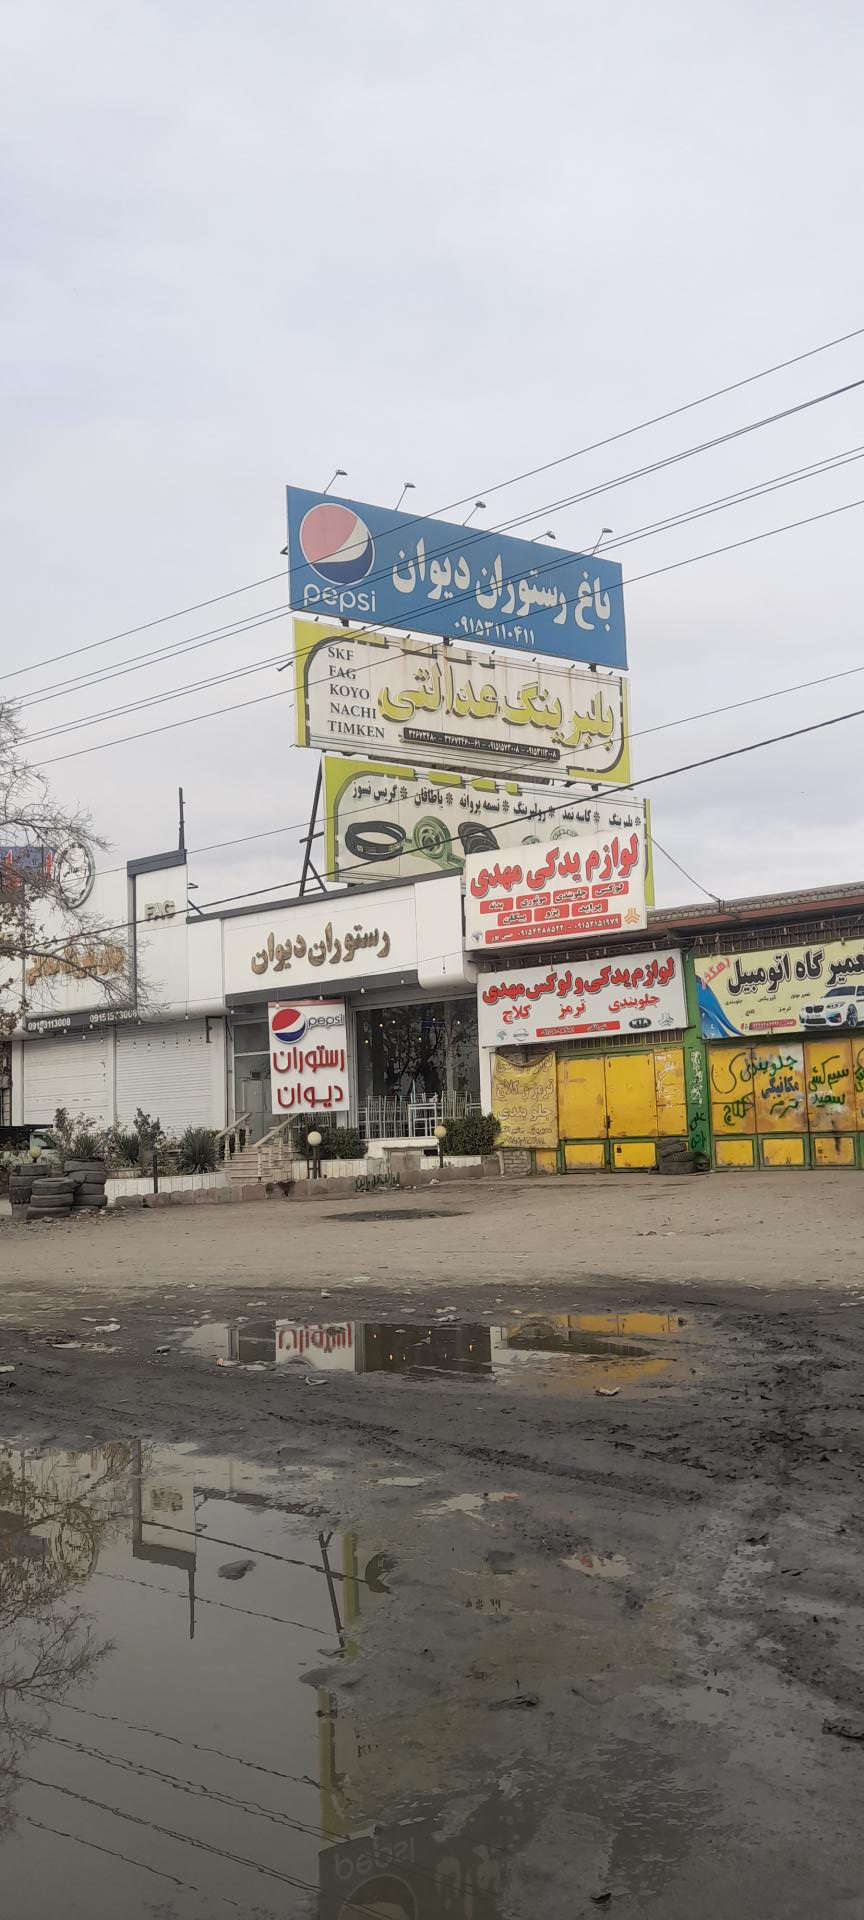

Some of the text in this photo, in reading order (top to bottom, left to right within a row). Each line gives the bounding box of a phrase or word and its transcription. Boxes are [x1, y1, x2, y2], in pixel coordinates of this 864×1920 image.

[303, 583, 376, 613] pepsi
[392, 537, 612, 632] باغ رستوران دیوان
[328, 646, 354, 661] SKF
[329, 665, 357, 680] FAG
[329, 683, 370, 700] KOYO
[330, 702, 377, 719] NACHI
[500, 680, 616, 752] بلبرینگ
[327, 720, 385, 738] TIMKEN
[470, 832, 640, 898] لوازم یدکی مهدی
[250, 921, 391, 975] رستوران دیوان
[482, 957, 675, 1005] لوازم یدکی و لوکس مهدی
[728, 948, 864, 995] عمیر گاه اتومبیل
[558, 999, 587, 1020] ترمز
[608, 992, 661, 1014] جلوبندی
[307, 1012, 345, 1030] pepsi
[272, 1045, 345, 1074] رستوران
[277, 1082, 344, 1109] دیوان
